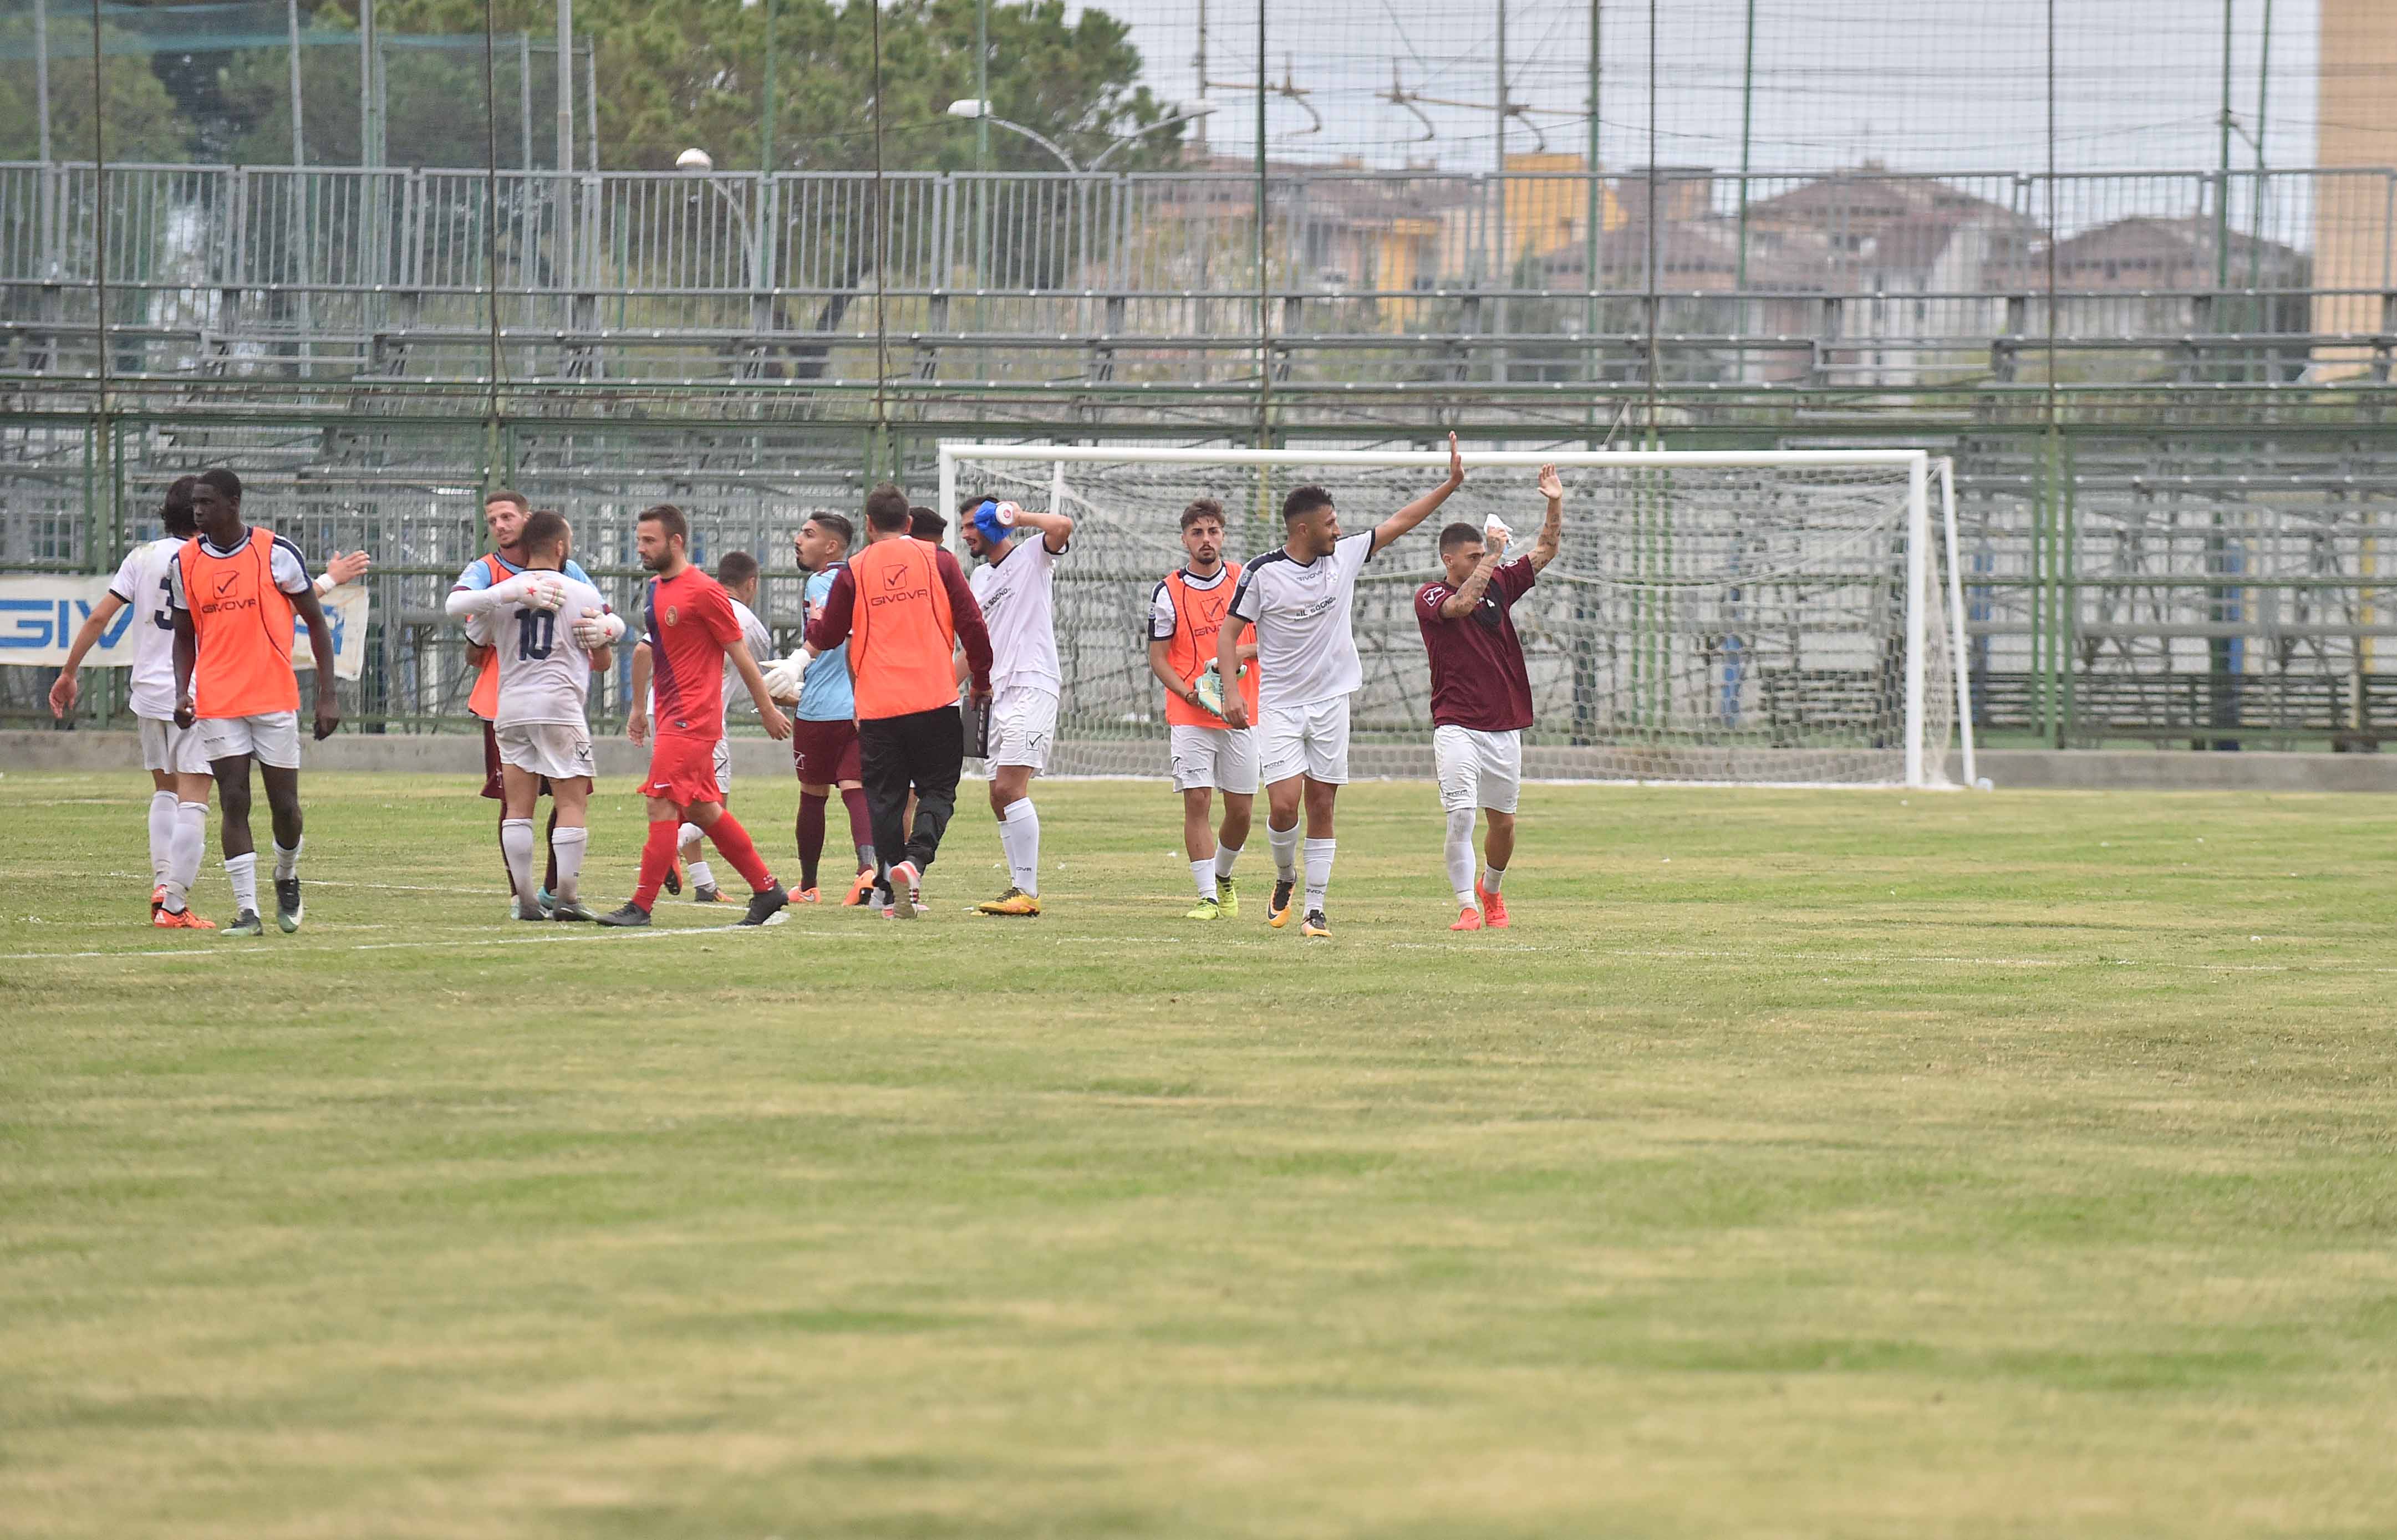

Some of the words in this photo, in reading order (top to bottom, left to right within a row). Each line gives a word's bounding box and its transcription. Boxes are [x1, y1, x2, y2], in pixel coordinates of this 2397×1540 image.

[201, 598, 256, 614] GIVOVA
[871, 589, 928, 606] GIVOVA
[513, 608, 555, 661] 10
